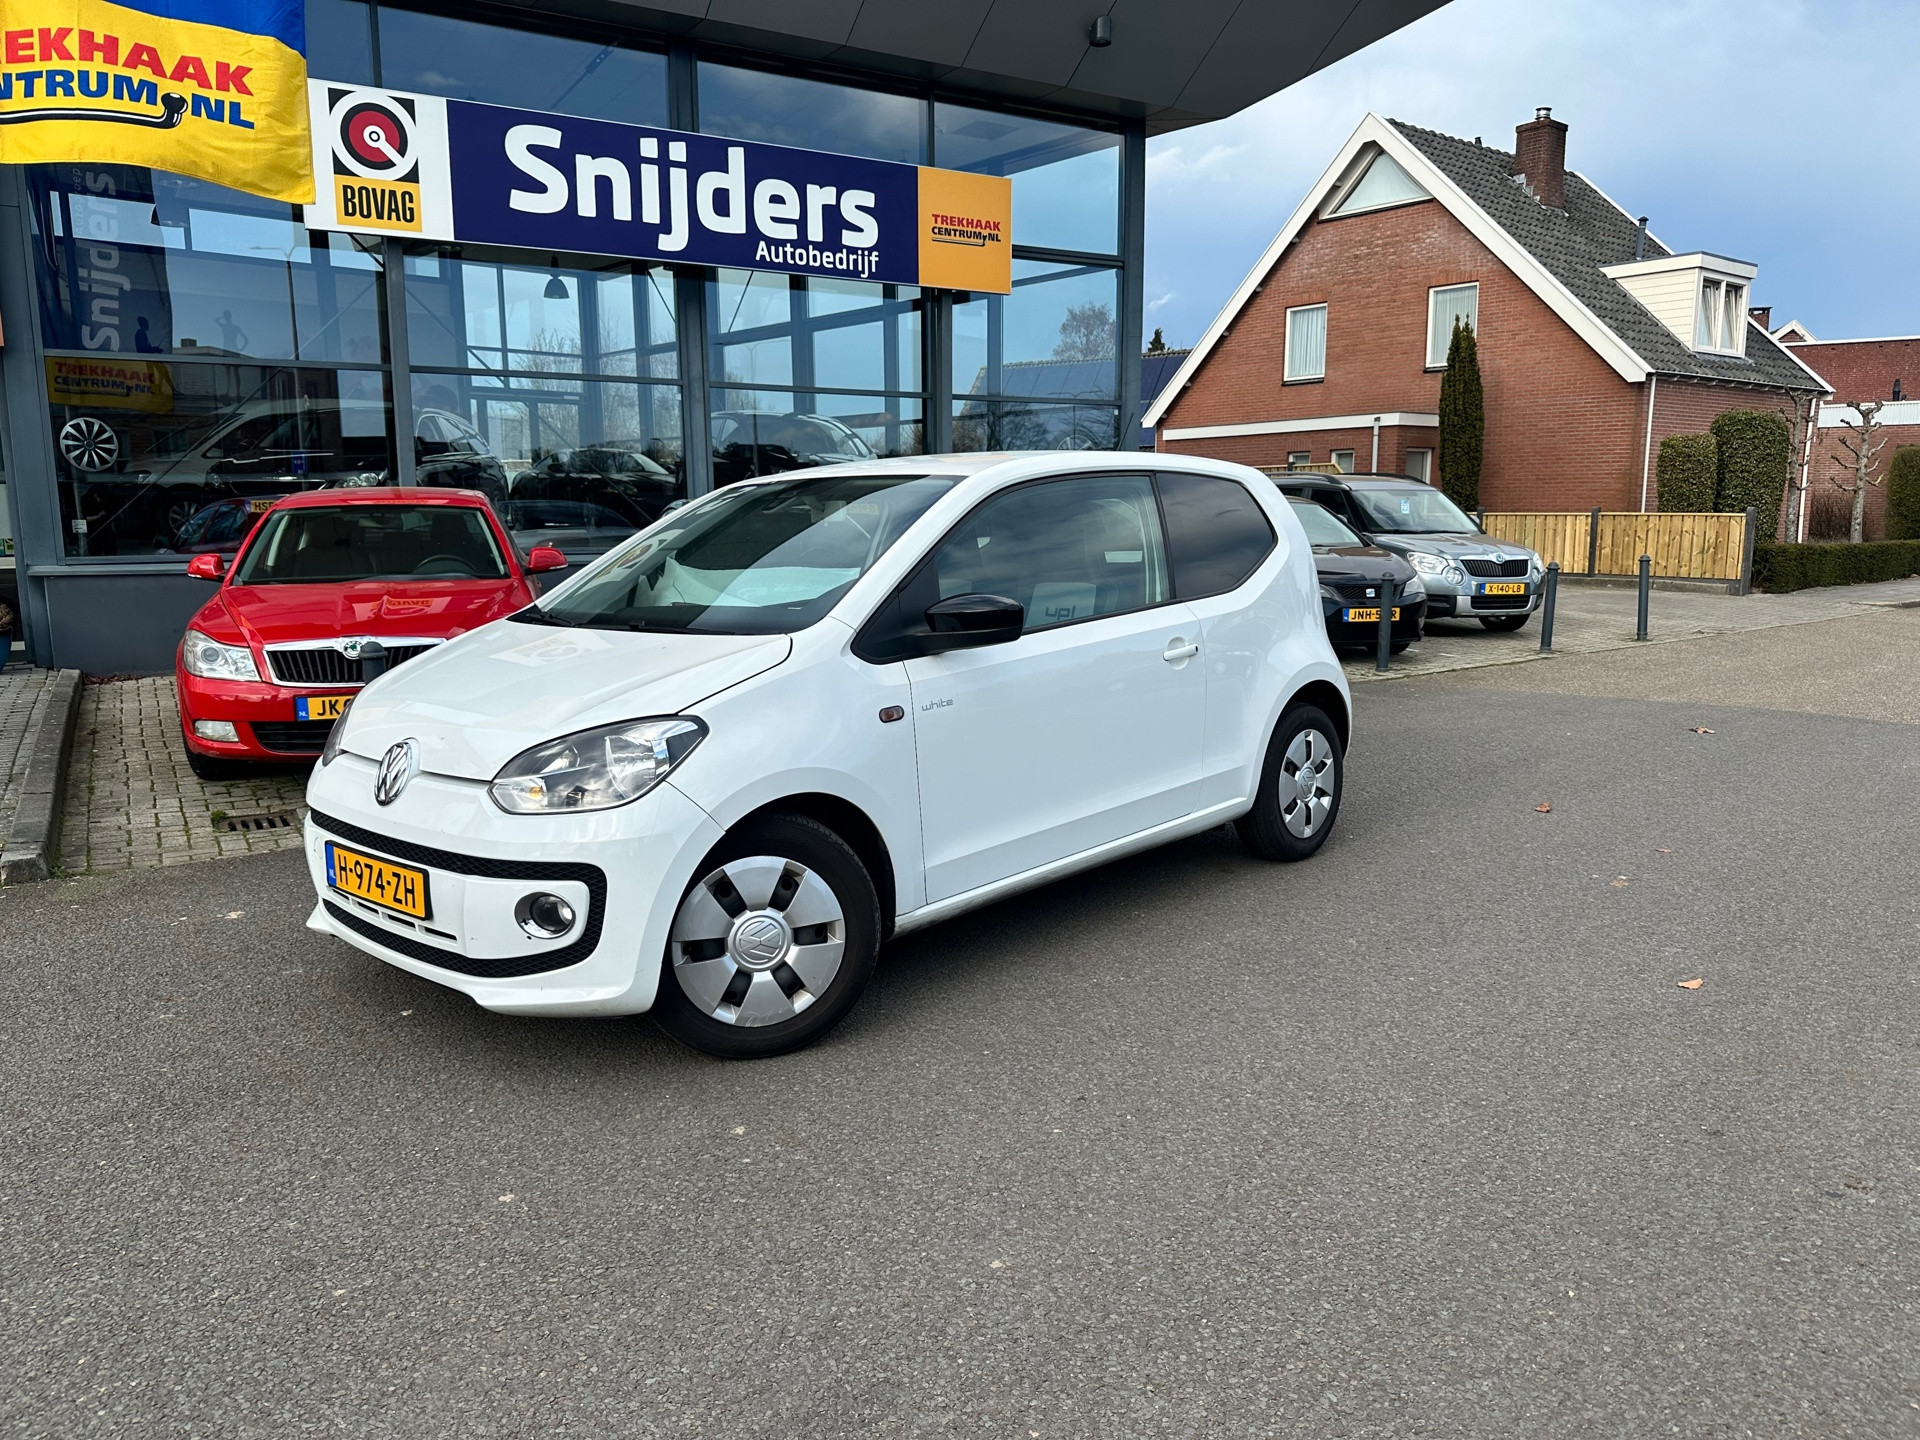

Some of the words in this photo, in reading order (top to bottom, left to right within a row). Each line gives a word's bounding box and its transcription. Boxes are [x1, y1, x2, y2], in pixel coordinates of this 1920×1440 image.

[0, 27, 254, 97] EKHAAK
[342, 184, 415, 223] BOVAG
[504, 124, 879, 252] Snijders
[932, 213, 1001, 232] TREKHAAK
[78, 171, 131, 352] Snijders
[755, 240, 879, 278] Autobedrijf
[55, 362, 155, 385] TREKHAAK
[921, 697, 954, 712] white
[337, 853, 416, 909] H-974-ZH
